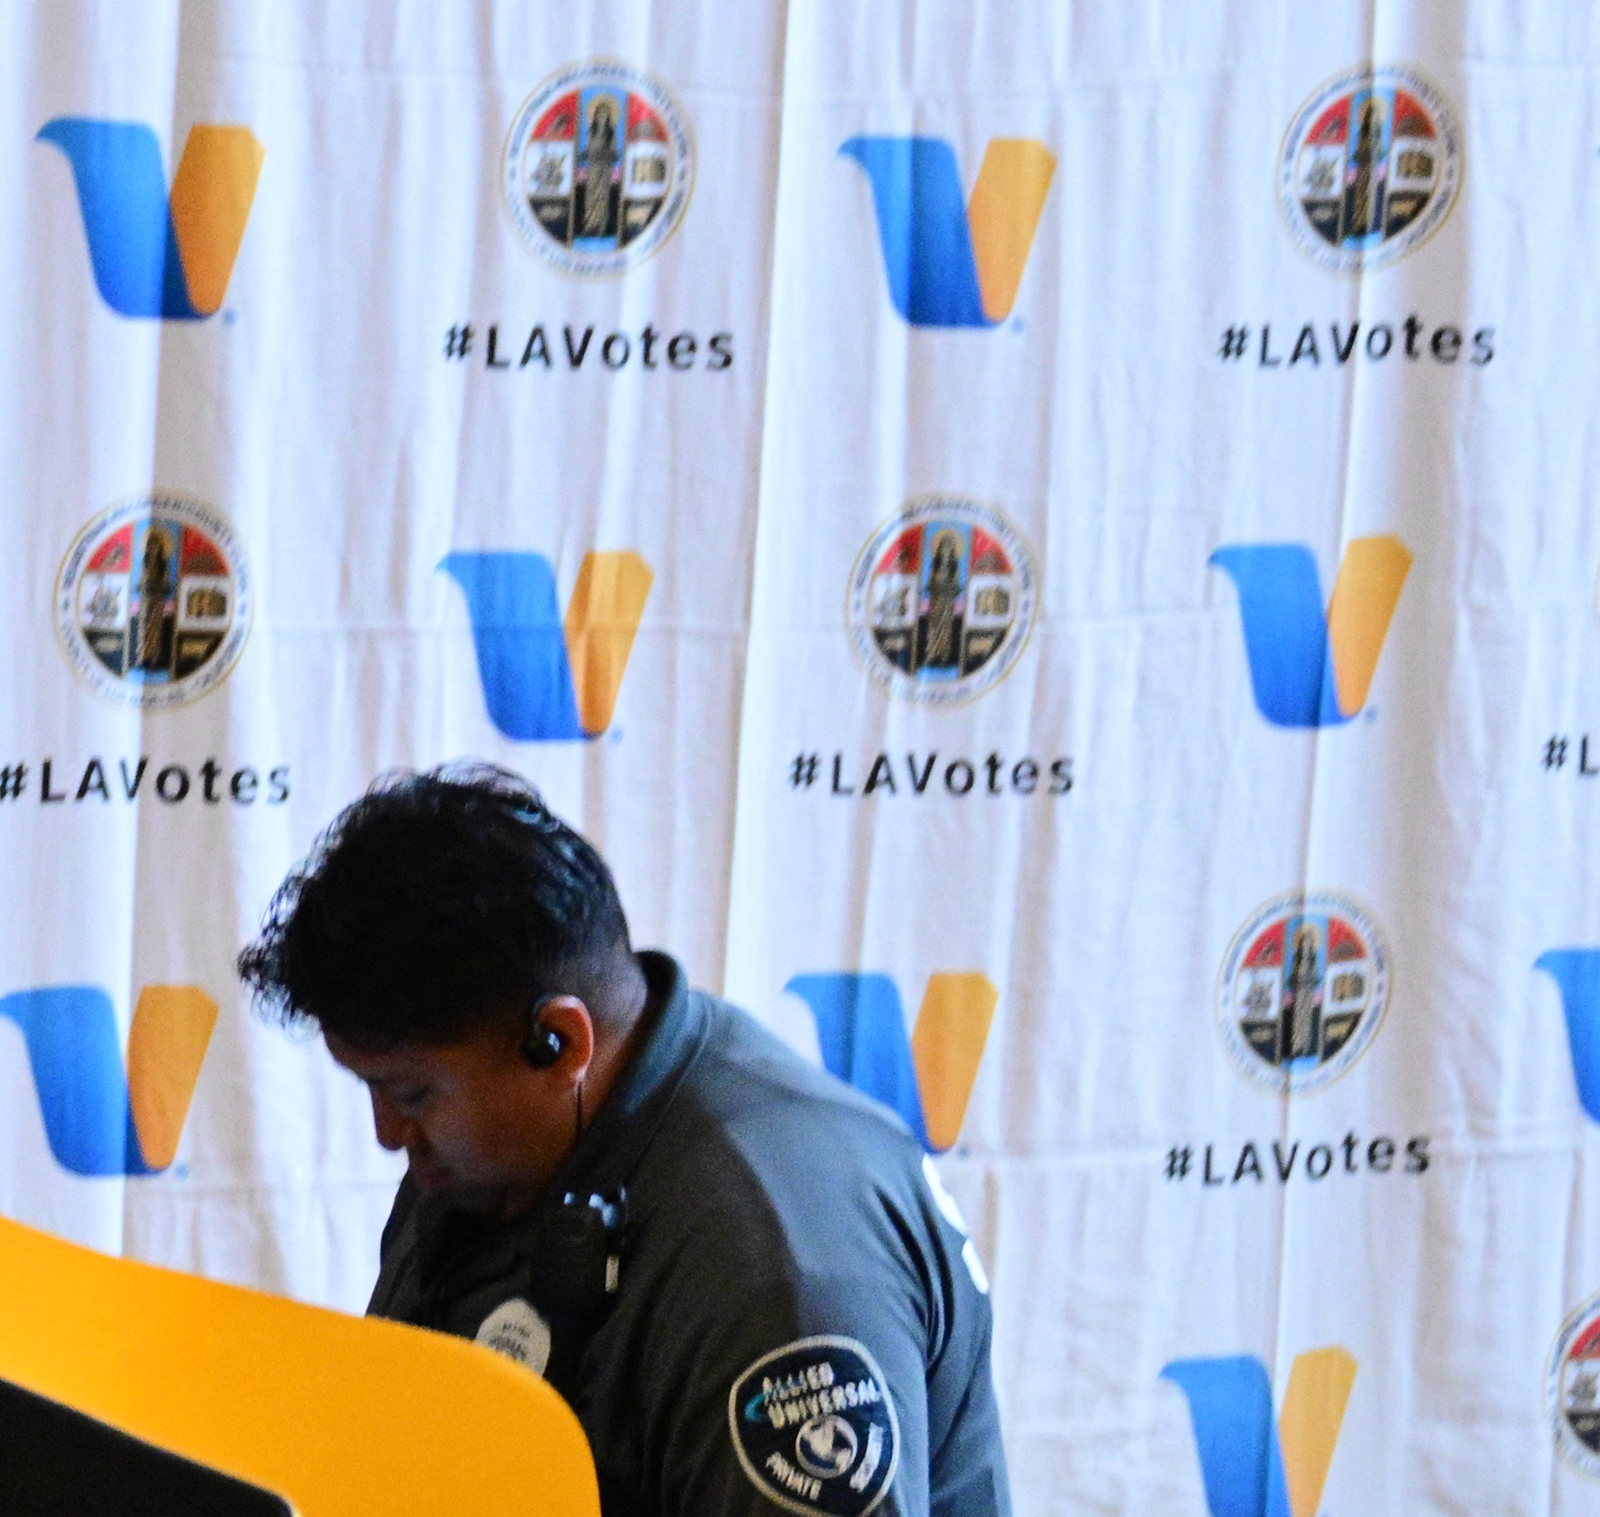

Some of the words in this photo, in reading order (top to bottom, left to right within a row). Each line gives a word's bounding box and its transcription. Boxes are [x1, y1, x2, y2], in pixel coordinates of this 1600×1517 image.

[444, 322, 734, 372] #LAVotes
[1219, 313, 1496, 367] #LAVotes
[788, 751, 1075, 800] #LAVotes
[1164, 1132, 1432, 1187] #LAVotes
